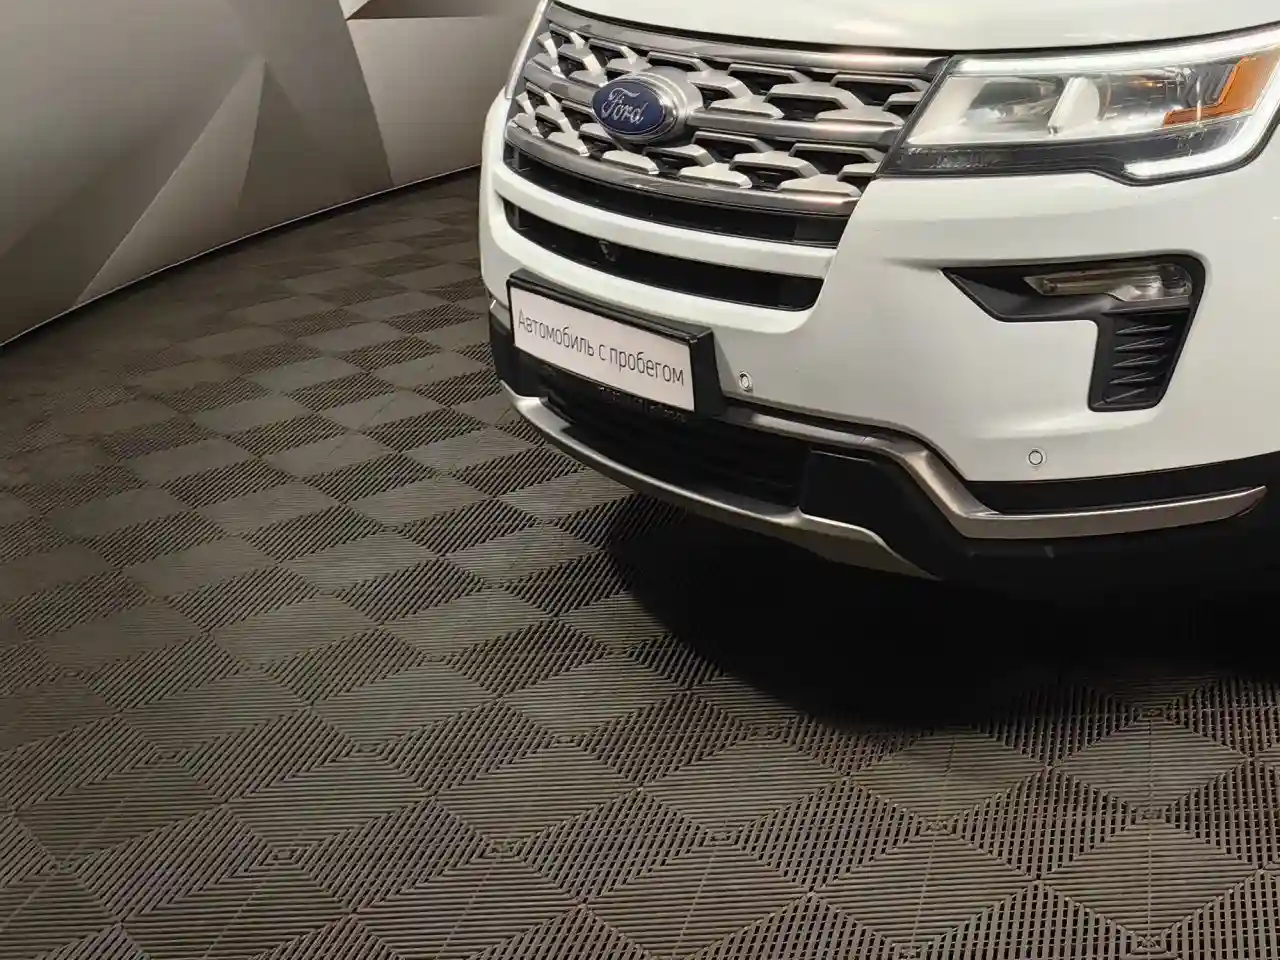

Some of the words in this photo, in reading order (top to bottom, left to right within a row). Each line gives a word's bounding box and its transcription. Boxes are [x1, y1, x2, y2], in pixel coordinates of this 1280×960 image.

[601, 87, 649, 125] Ford
[517, 307, 595, 358] Автомобиль
[598, 343, 606, 362] с
[609, 347, 685, 386] пробегом
